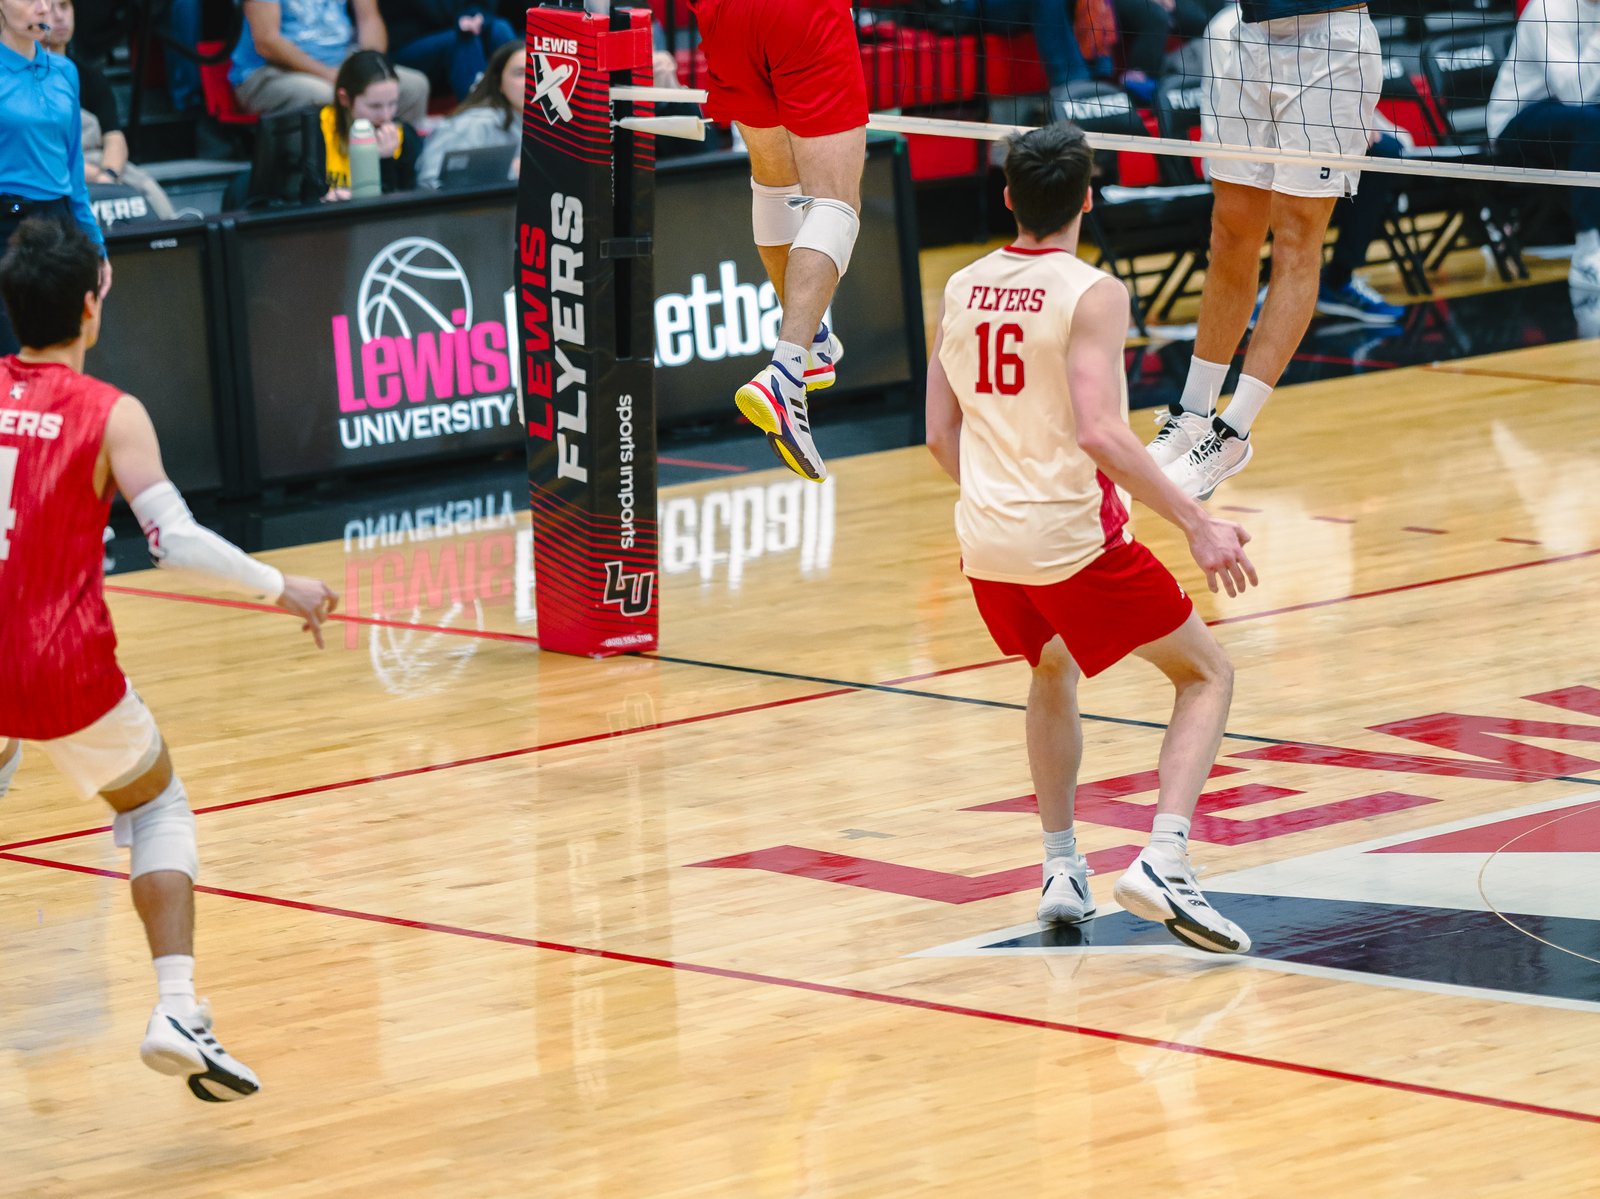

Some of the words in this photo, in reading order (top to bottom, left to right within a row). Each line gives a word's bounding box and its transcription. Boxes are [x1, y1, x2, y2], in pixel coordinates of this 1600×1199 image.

[533, 36, 578, 55] LEWIS
[520, 223, 553, 441] LEWIS
[967, 285, 1046, 313] FLYERS
[332, 308, 510, 412] Lewis
[550, 192, 589, 484] FLYERS
[975, 322, 1024, 396] 16
[338, 393, 515, 449] UNIVERSITY
[616, 394, 636, 463] sports
[618, 466, 637, 549] imports
[603, 560, 655, 617] LU
